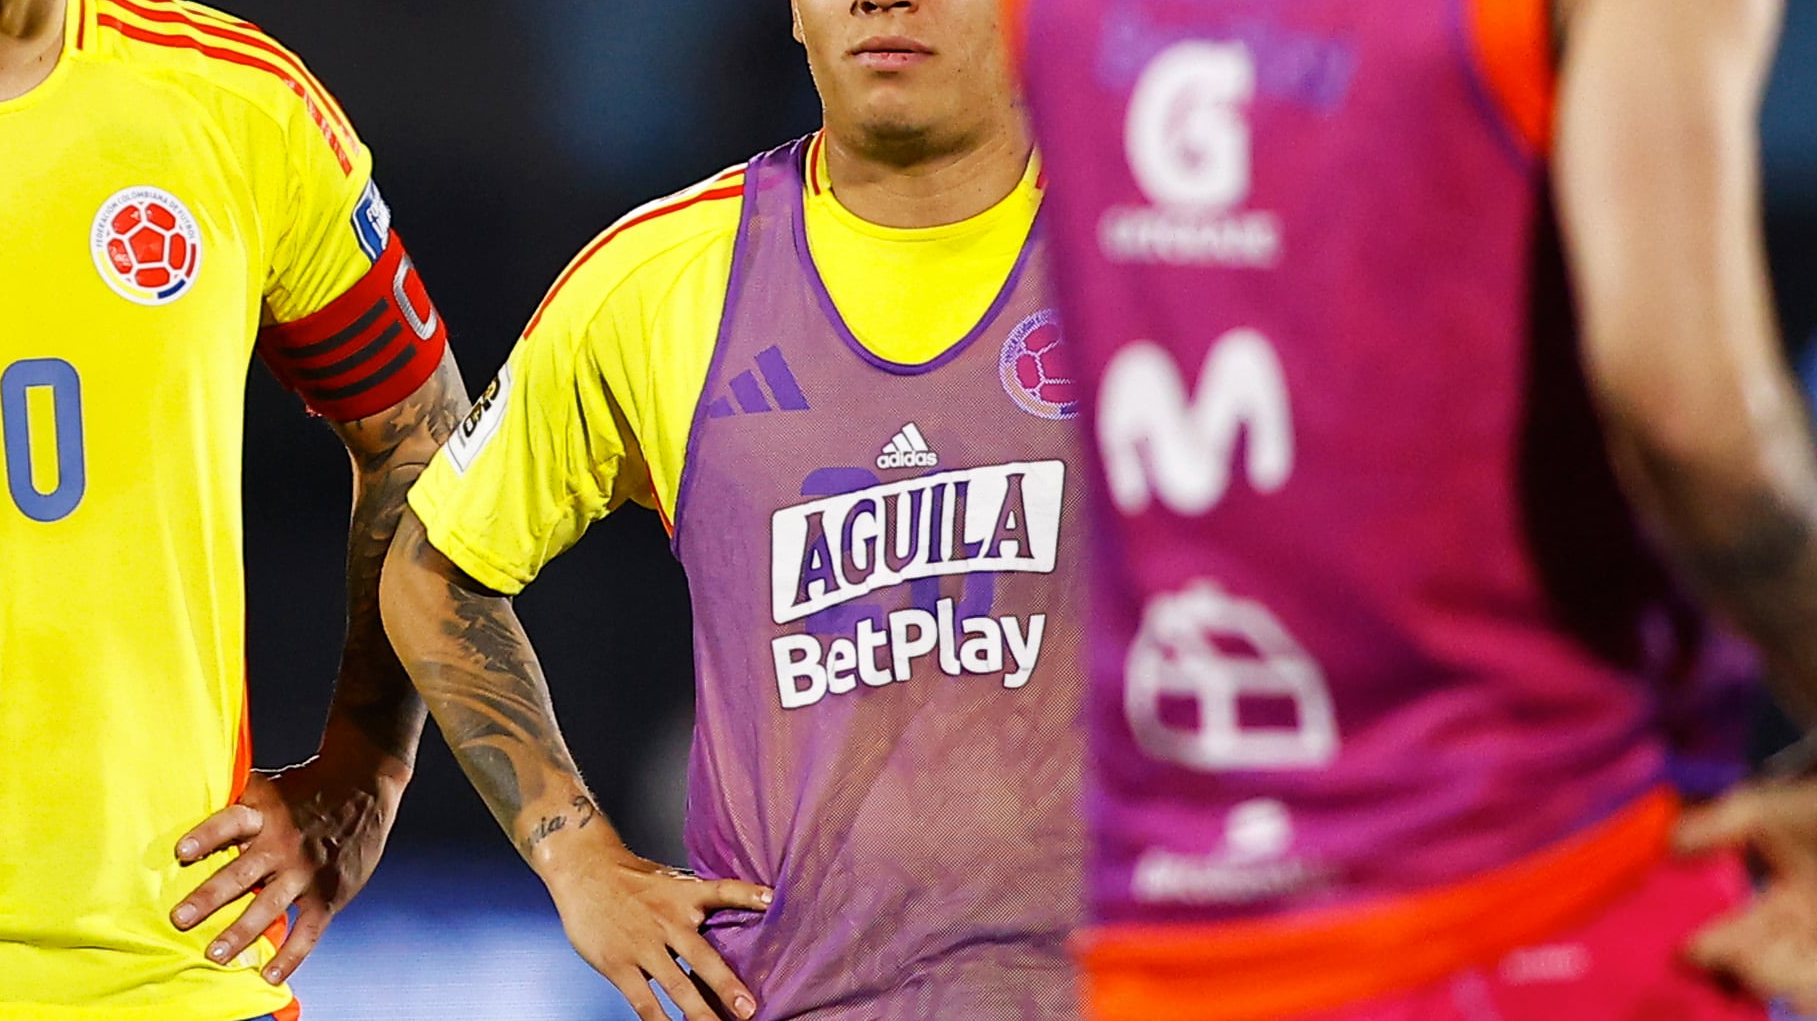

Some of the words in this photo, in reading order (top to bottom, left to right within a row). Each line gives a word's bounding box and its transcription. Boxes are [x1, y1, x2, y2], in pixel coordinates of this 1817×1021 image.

[876, 450, 938, 470] adidas
[789, 472, 1037, 610] AGUILA
[771, 597, 1046, 710] BetPlay
